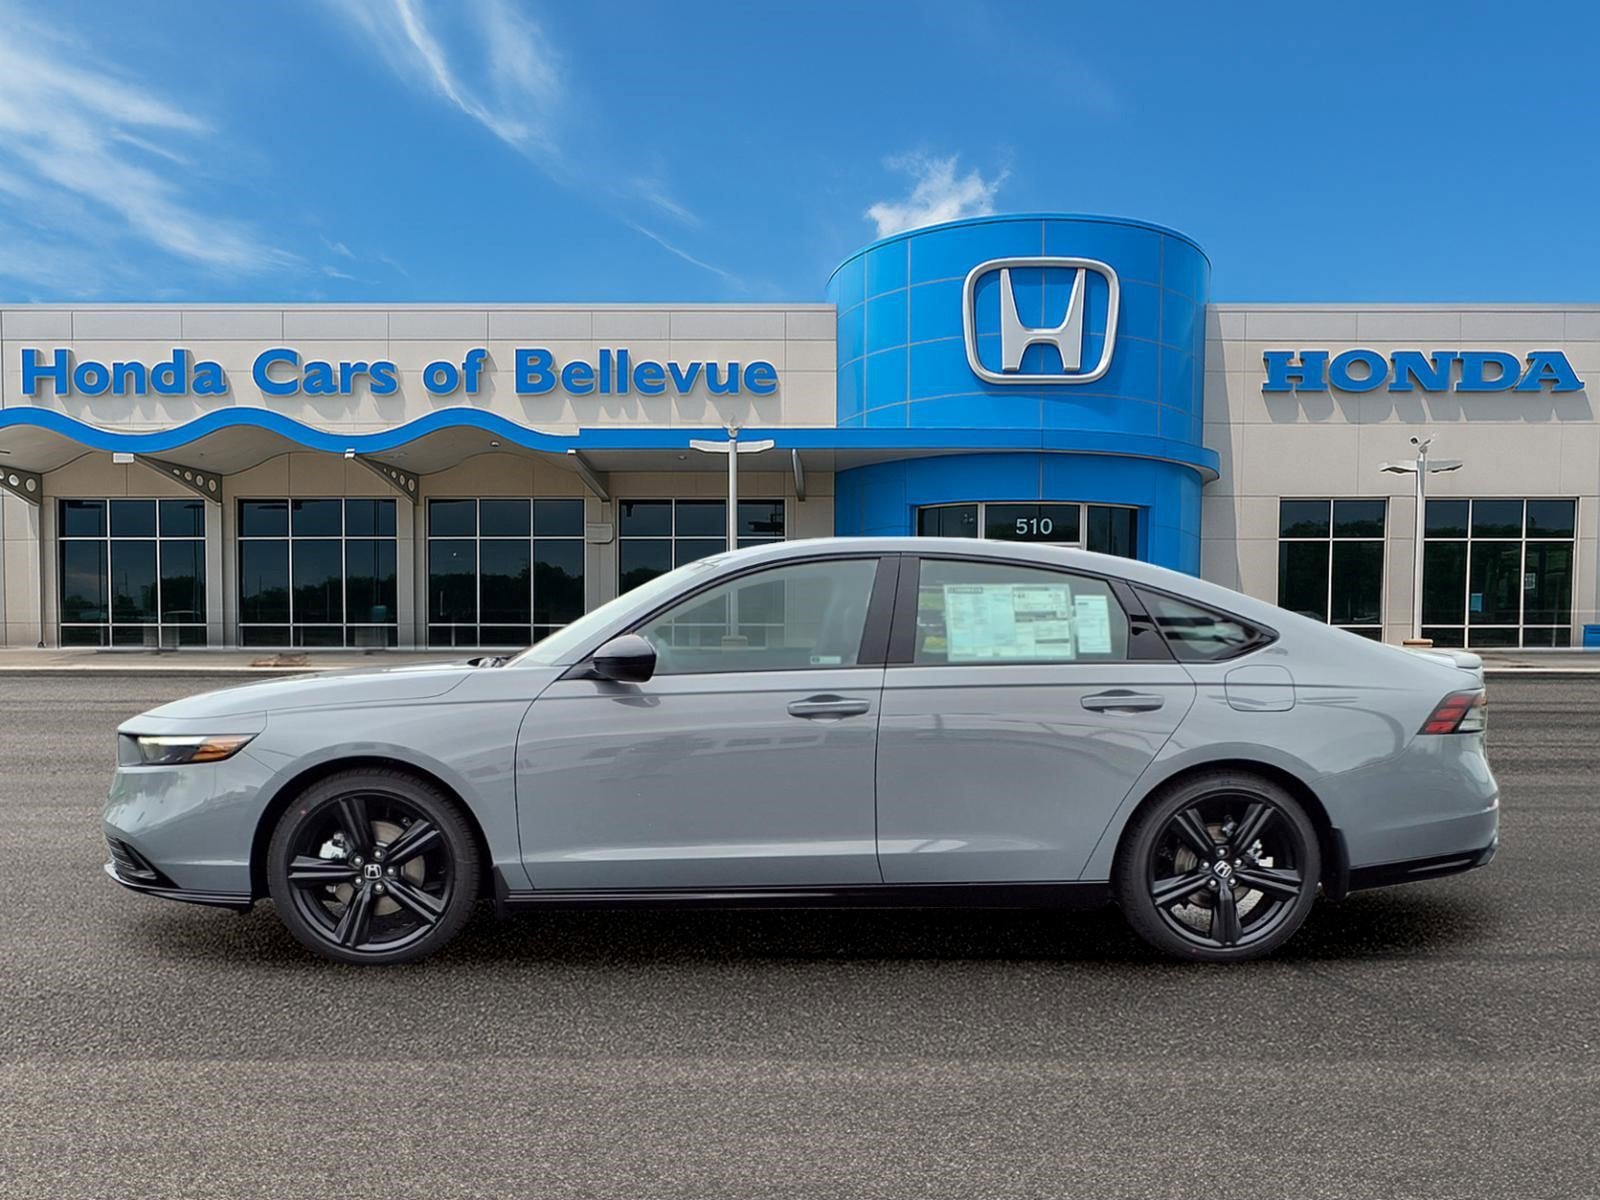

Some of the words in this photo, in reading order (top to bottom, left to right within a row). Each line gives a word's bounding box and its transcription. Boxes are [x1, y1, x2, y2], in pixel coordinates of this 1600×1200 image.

[21, 348, 228, 396] Honda
[252, 347, 398, 396] Cars
[423, 345, 488, 395] of
[515, 347, 778, 396] Bellevue
[1261, 349, 1585, 393] HONDA
[1016, 518, 1053, 535] 510
